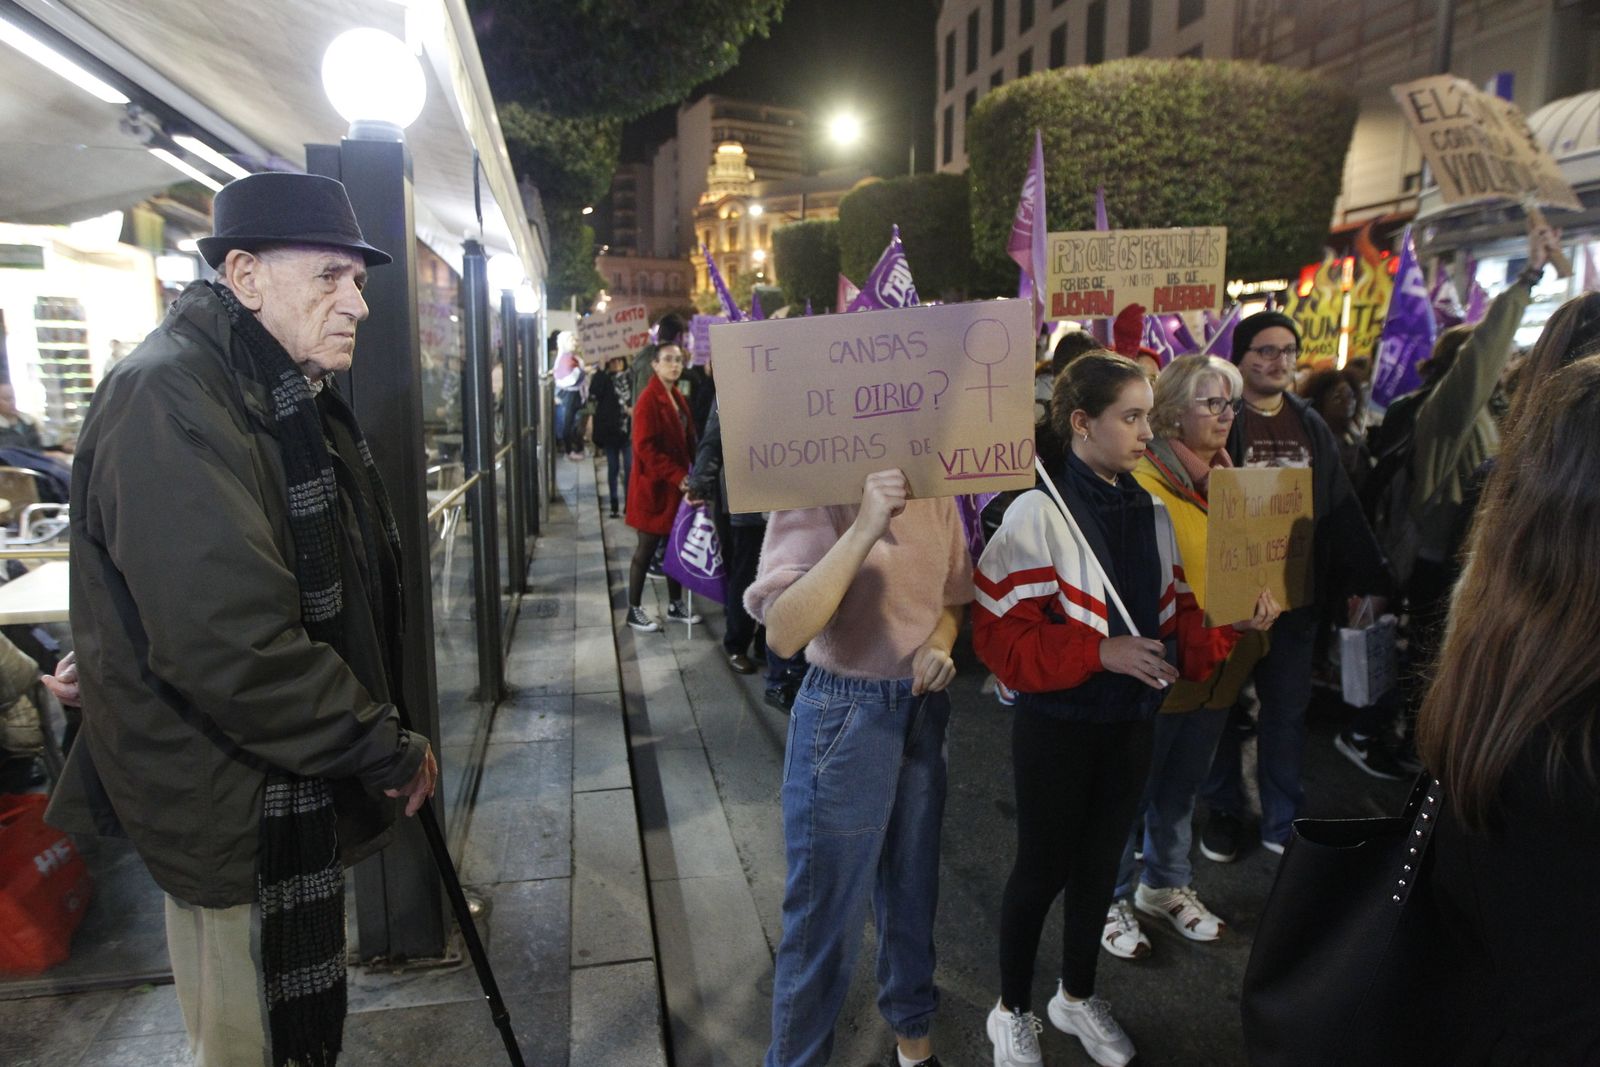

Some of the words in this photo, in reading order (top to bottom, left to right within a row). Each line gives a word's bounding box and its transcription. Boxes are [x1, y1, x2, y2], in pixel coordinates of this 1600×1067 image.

[1118, 236, 1140, 270] OS
[1153, 284, 1216, 312] MUEREN
[743, 345, 780, 373] TE
[829, 331, 928, 364] CANSAS
[807, 388, 836, 417] DE
[750, 433, 887, 472] NOSOTRAS
[910, 439, 932, 456] DE
